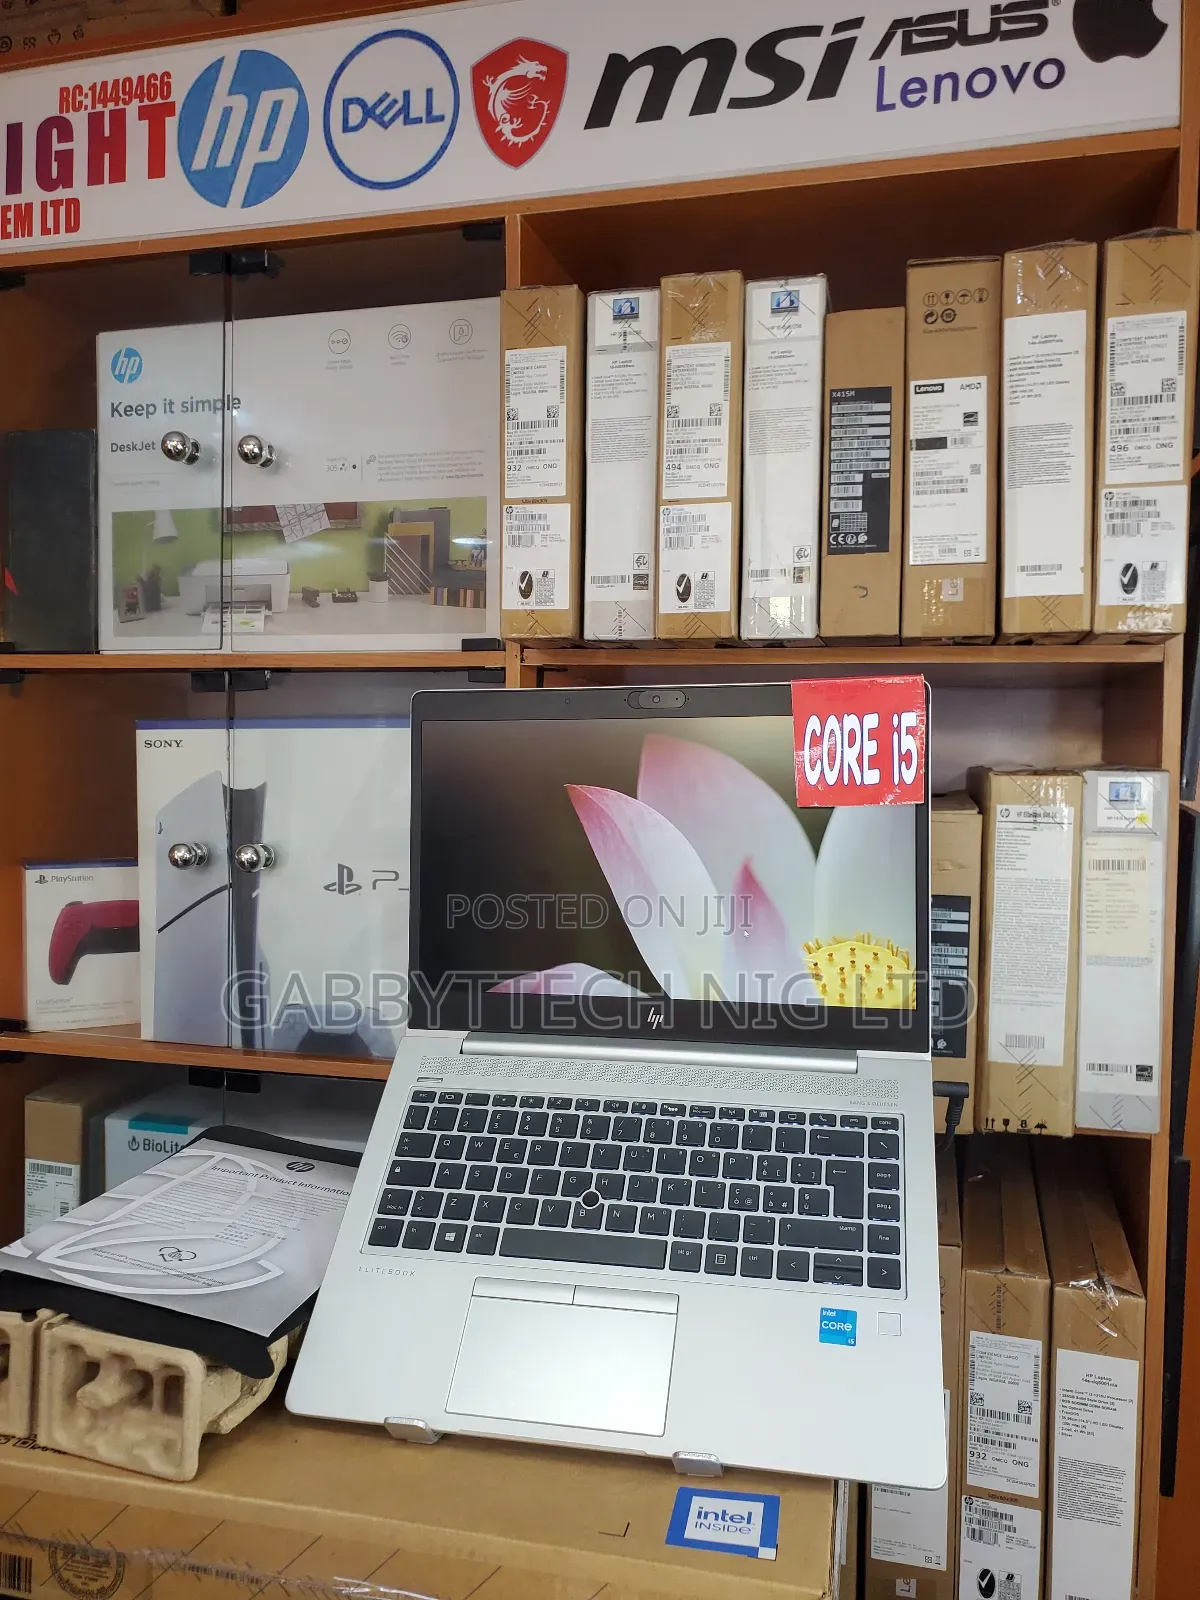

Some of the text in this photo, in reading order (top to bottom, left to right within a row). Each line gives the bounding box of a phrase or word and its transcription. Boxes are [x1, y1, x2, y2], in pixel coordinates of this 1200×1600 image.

[869, 0, 1049, 61] ASUS
[583, 16, 865, 131] msi
[876, 57, 1066, 112] Lenovo
[59, 71, 172, 114] RC:1449466
[342, 88, 444, 134] DELL
[186, 49, 302, 209] hp
[5, 101, 176, 195] IGHT
[0, 197, 81, 240] EM LTD
[112, 347, 143, 384] hp
[916, 384, 943, 393] Lenovo
[832, 390, 855, 398] X415M
[110, 394, 241, 419] Keep it simple
[110, 441, 156, 452] DeskJet
[1109, 444, 1129, 453] 496
[506, 464, 522, 472] 932
[665, 463, 682, 471] 494
[144, 739, 183, 748] SONY
[803, 711, 919, 787] CORE i5
[51, 874, 94, 884] PlayStation
[535, 1144, 541, 1152] R
[599, 1148, 606, 1156] Y
[630, 1150, 638, 1158] U
[729, 1157, 736, 1165] P
[211, 1165, 259, 1179] Important
[259, 1173, 298, 1187] Product
[667, 1183, 675, 1191] K
[701, 1186, 707, 1194] L
[450, 1198, 458, 1206] Z
[482, 1200, 490, 1208] X
[514, 1202, 522, 1211] C
[547, 1205, 555, 1213] V
[613, 1210, 621, 1218] N
[847, 1337, 855, 1345] i5
[1094, 1374, 1113, 1382] Laptop
[969, 1450, 987, 1461] 932
[1011, 1459, 1029, 1468] ONG
[696, 1506, 753, 1525] intel
